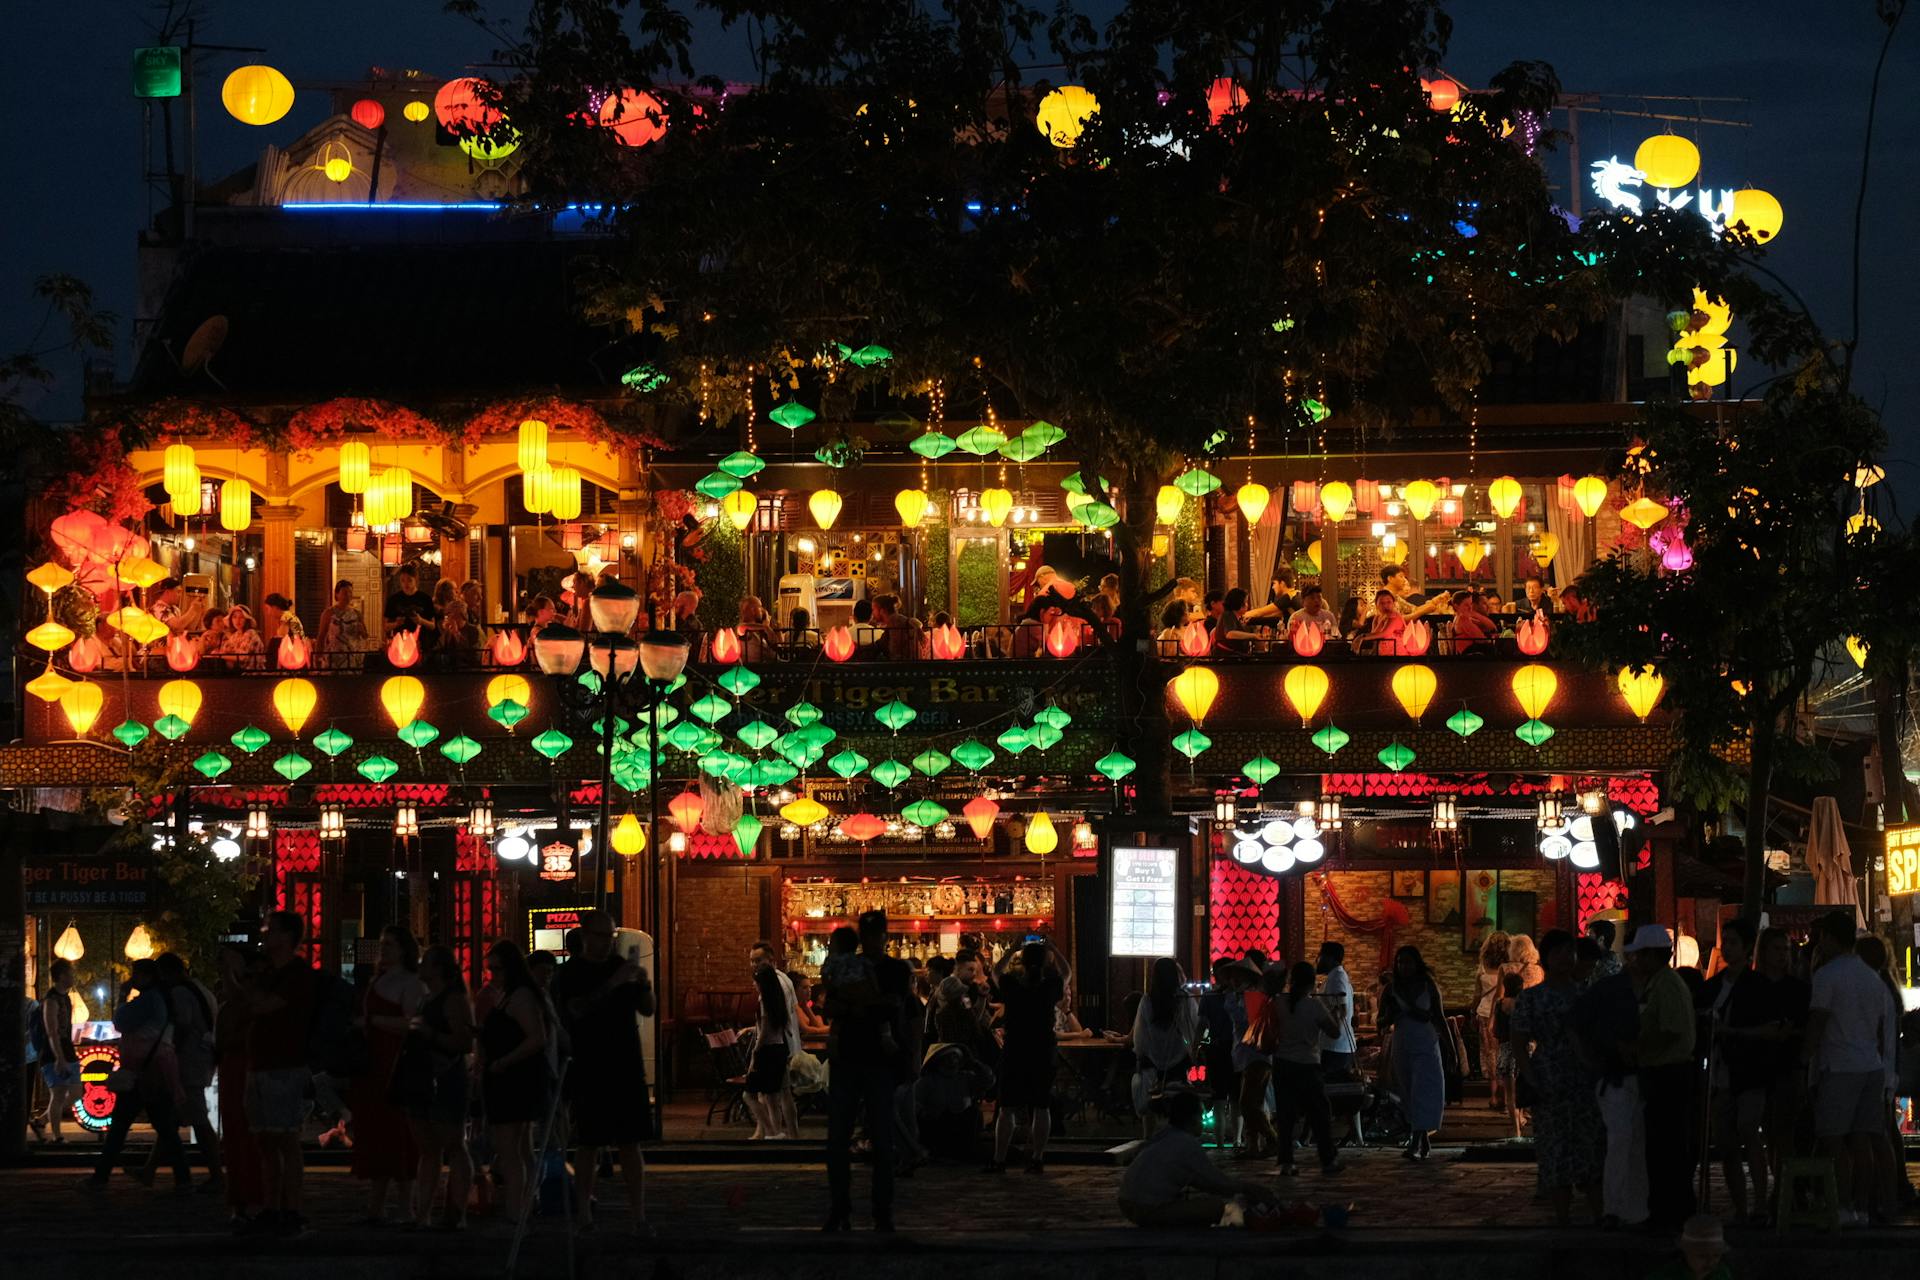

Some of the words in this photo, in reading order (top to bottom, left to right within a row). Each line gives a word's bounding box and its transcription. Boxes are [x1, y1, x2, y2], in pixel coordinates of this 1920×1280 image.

[683, 679, 787, 705] Ter
[800, 678, 913, 710] Tiger
[928, 677, 1009, 705] Bar
[543, 855, 573, 872] 35
[58, 862, 110, 885] Tiger
[114, 862, 147, 881] Bar
[34, 891, 48, 903] BE
[59, 890, 91, 903] PUSSY
[94, 890, 108, 903] BE
[118, 890, 146, 903] TIGER
[546, 912, 579, 923] PIZZA
